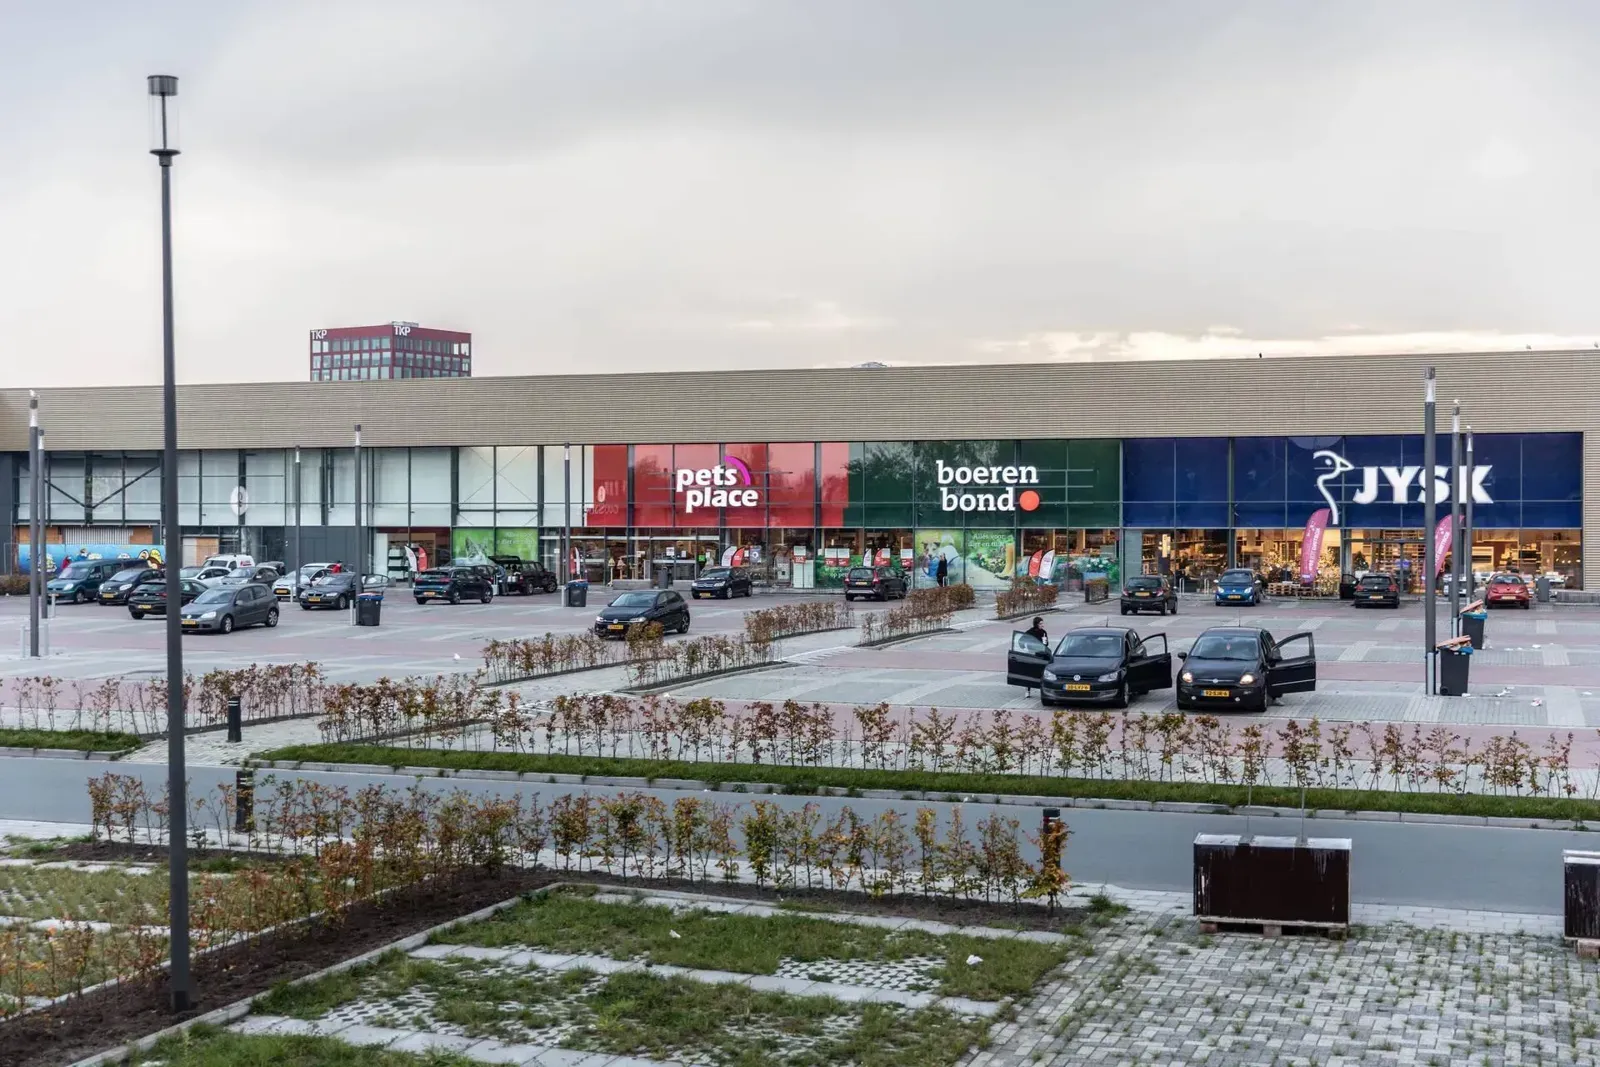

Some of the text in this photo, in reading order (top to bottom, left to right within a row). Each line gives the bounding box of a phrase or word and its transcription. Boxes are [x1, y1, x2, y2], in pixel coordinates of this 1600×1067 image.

[311, 329, 327, 340] TKP
[394, 325, 410, 336] TKP
[676, 465, 737, 493] pets
[935, 459, 1040, 484] boeren
[1352, 464, 1494, 505] JYSK
[685, 486, 759, 514] place
[940, 486, 1016, 512] bond
